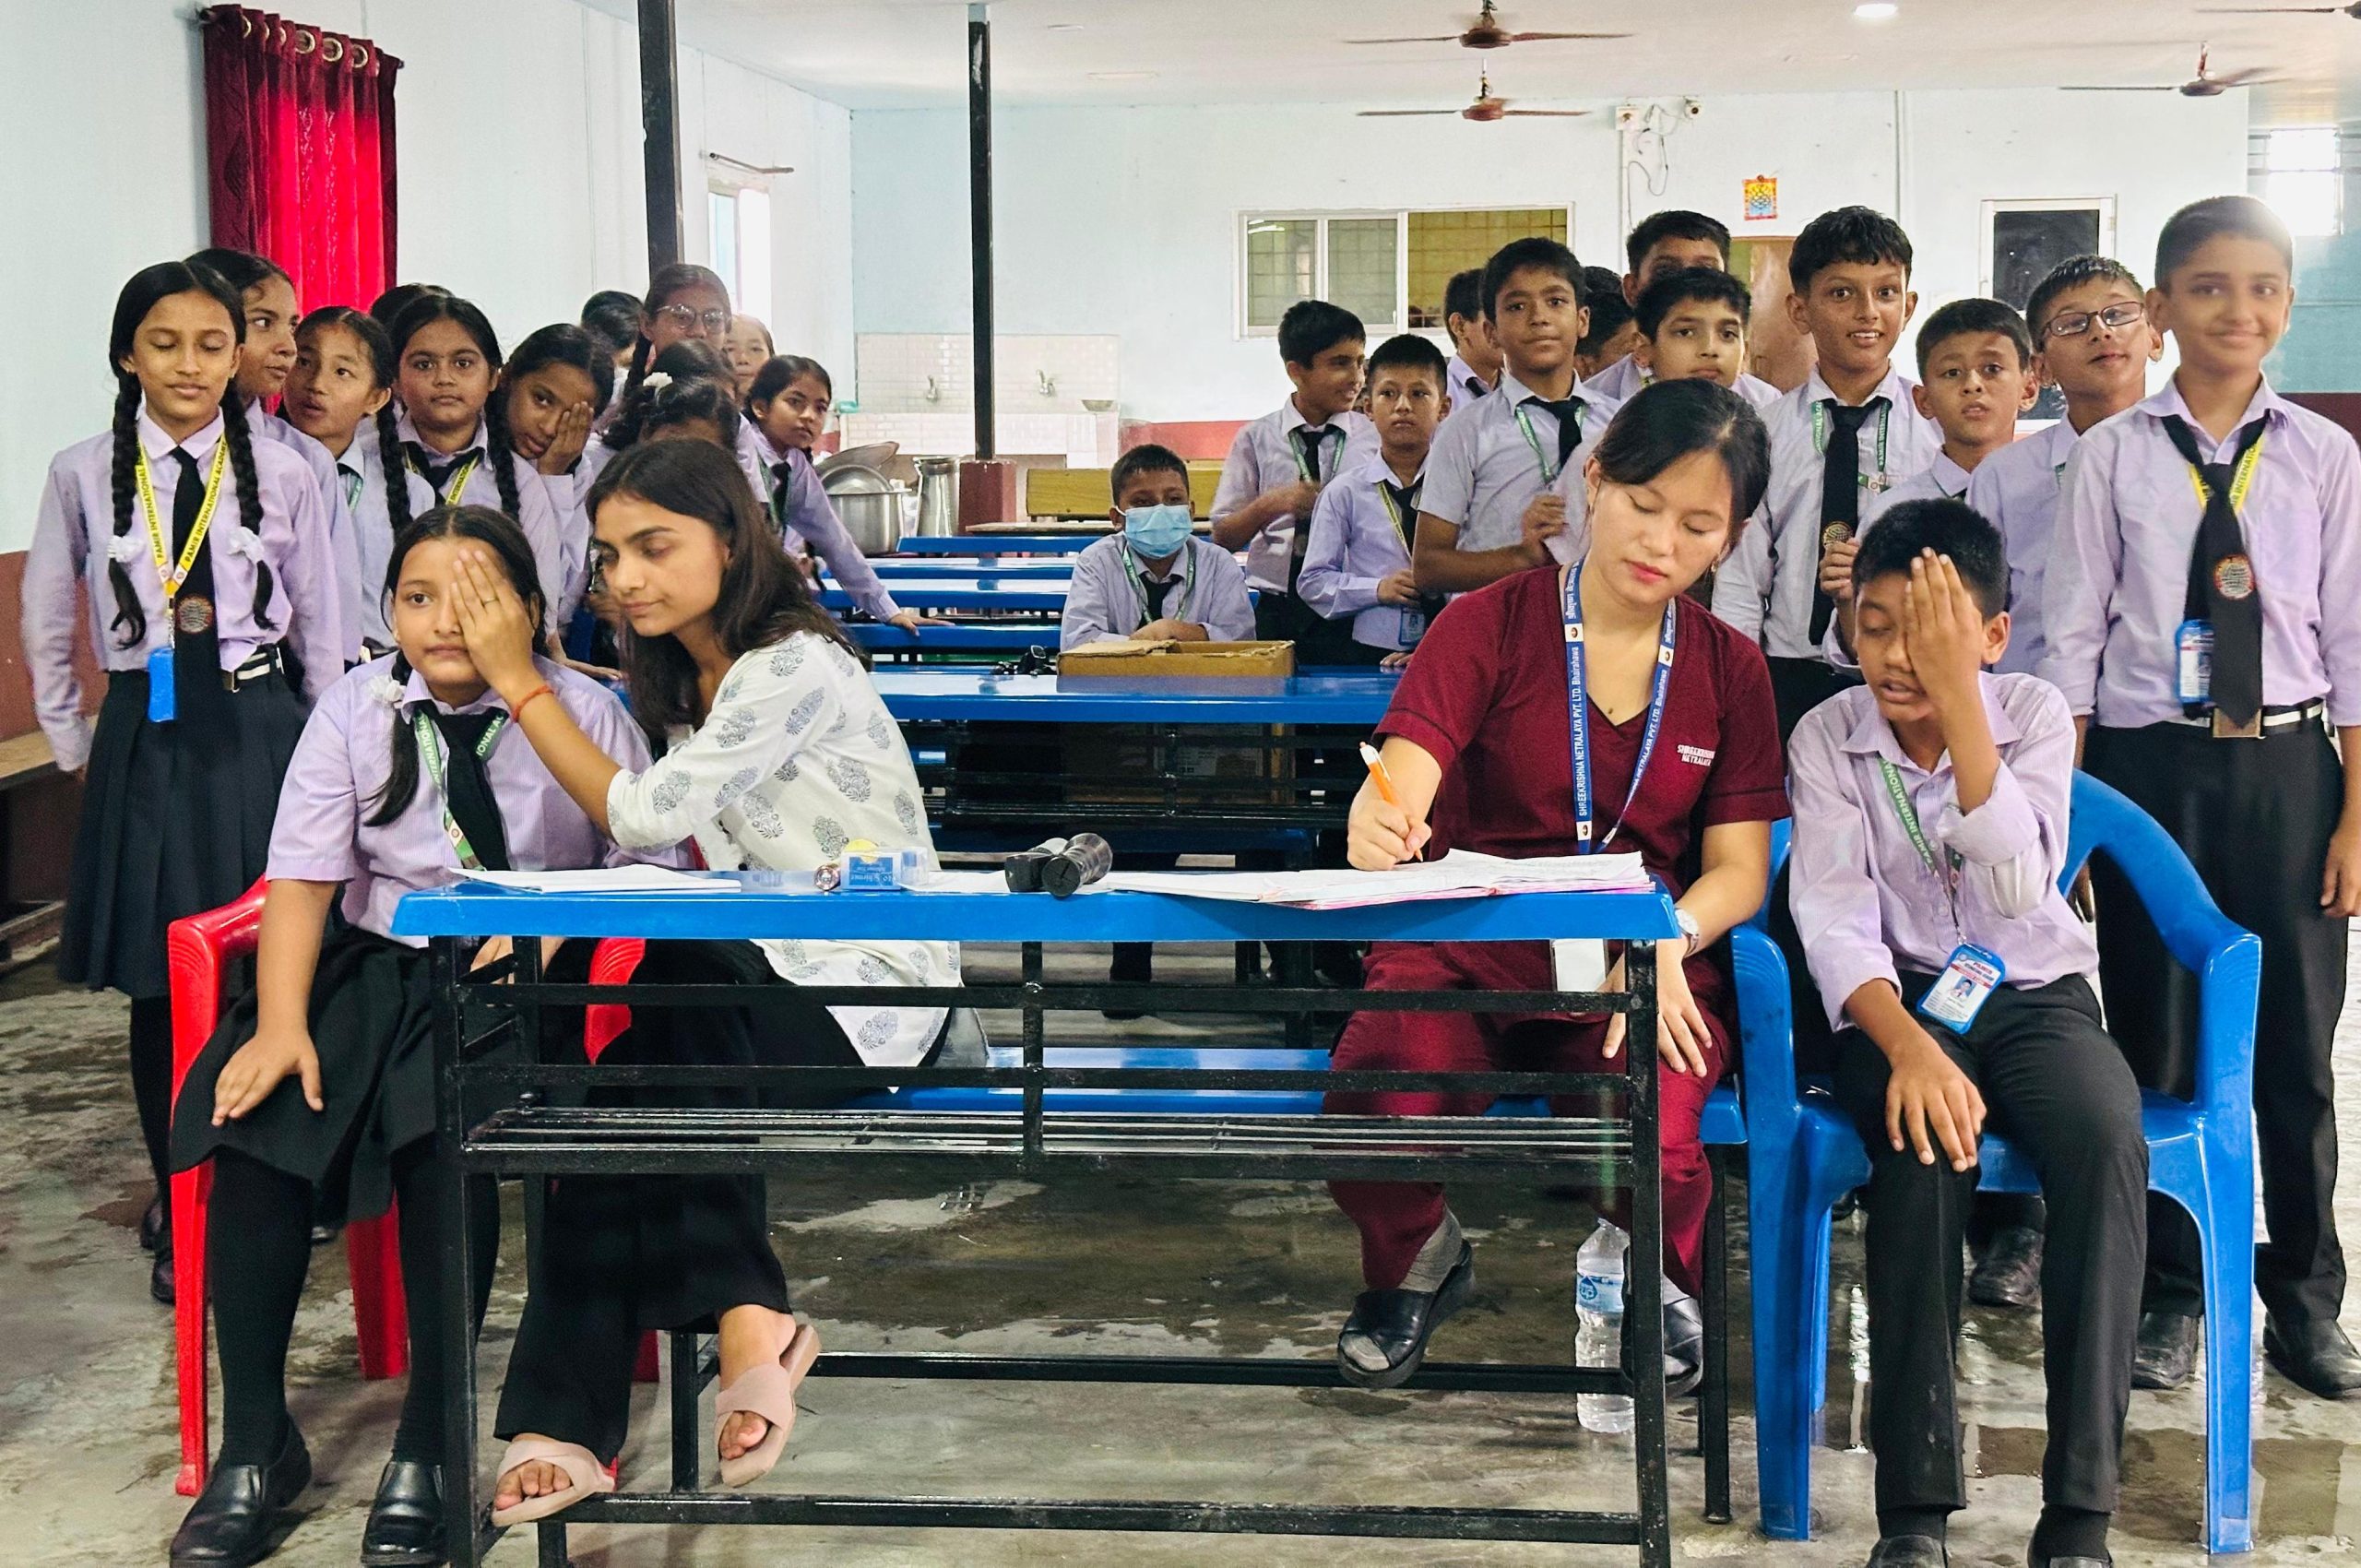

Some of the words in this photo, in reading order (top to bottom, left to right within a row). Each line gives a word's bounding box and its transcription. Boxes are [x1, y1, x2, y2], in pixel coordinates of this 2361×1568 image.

[137, 468, 158, 531] INTERNATIONAL
[184, 536, 199, 563] PAMIR
[196, 480, 220, 536] INTERNATIONAL
[152, 533, 164, 559] PAMIR
[1571, 647, 1581, 685] Bhairahawa
[1572, 686, 1582, 702] LTD.
[1572, 702, 1583, 718] PVT.
[1573, 718, 1584, 764] NETRALAYA
[1575, 763, 1588, 817] SHREEKRISHNA
[1914, 834, 1933, 863] PAMIR
